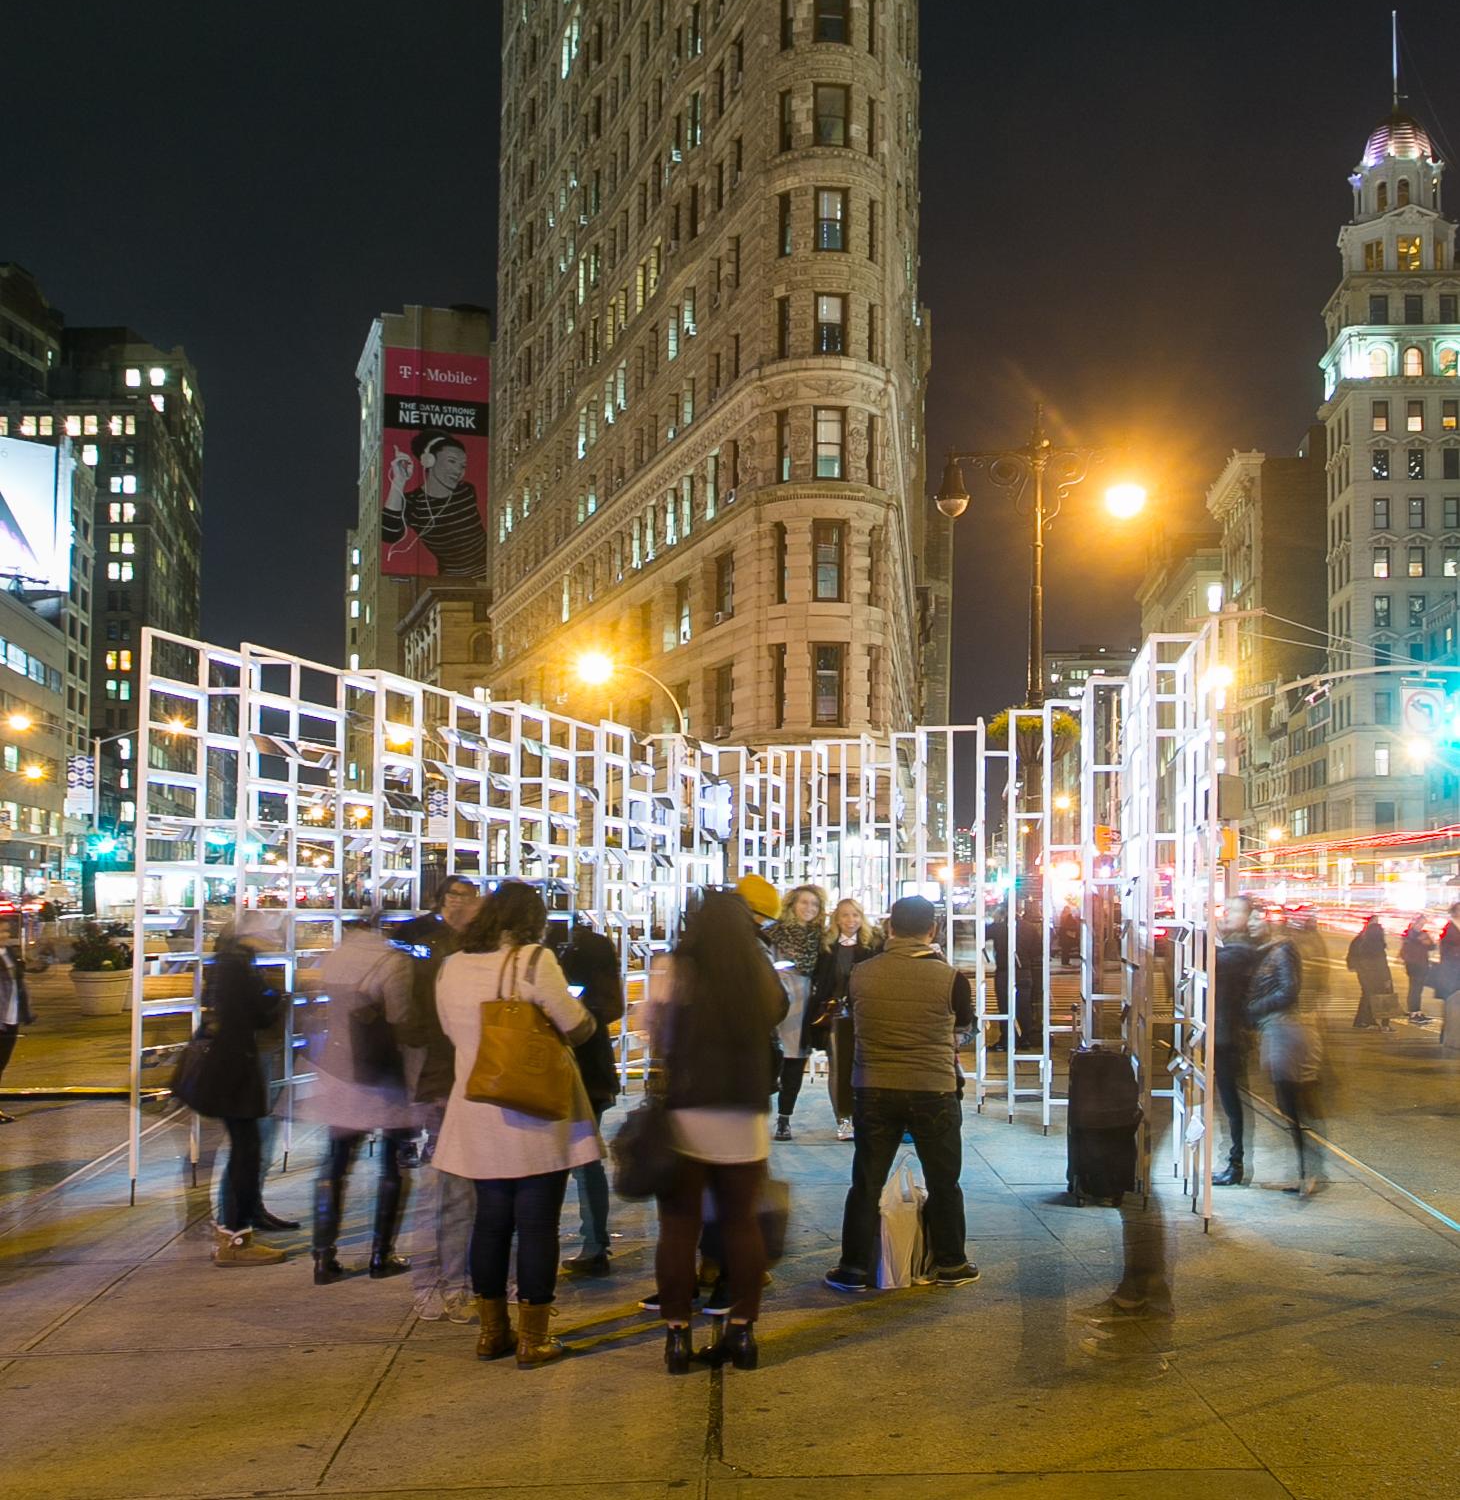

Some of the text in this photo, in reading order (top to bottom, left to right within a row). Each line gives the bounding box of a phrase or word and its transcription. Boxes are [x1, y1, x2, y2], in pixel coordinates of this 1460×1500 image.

[399, 402, 476, 416] THE DATA STRONG
[399, 410, 476, 429] NETWORK
